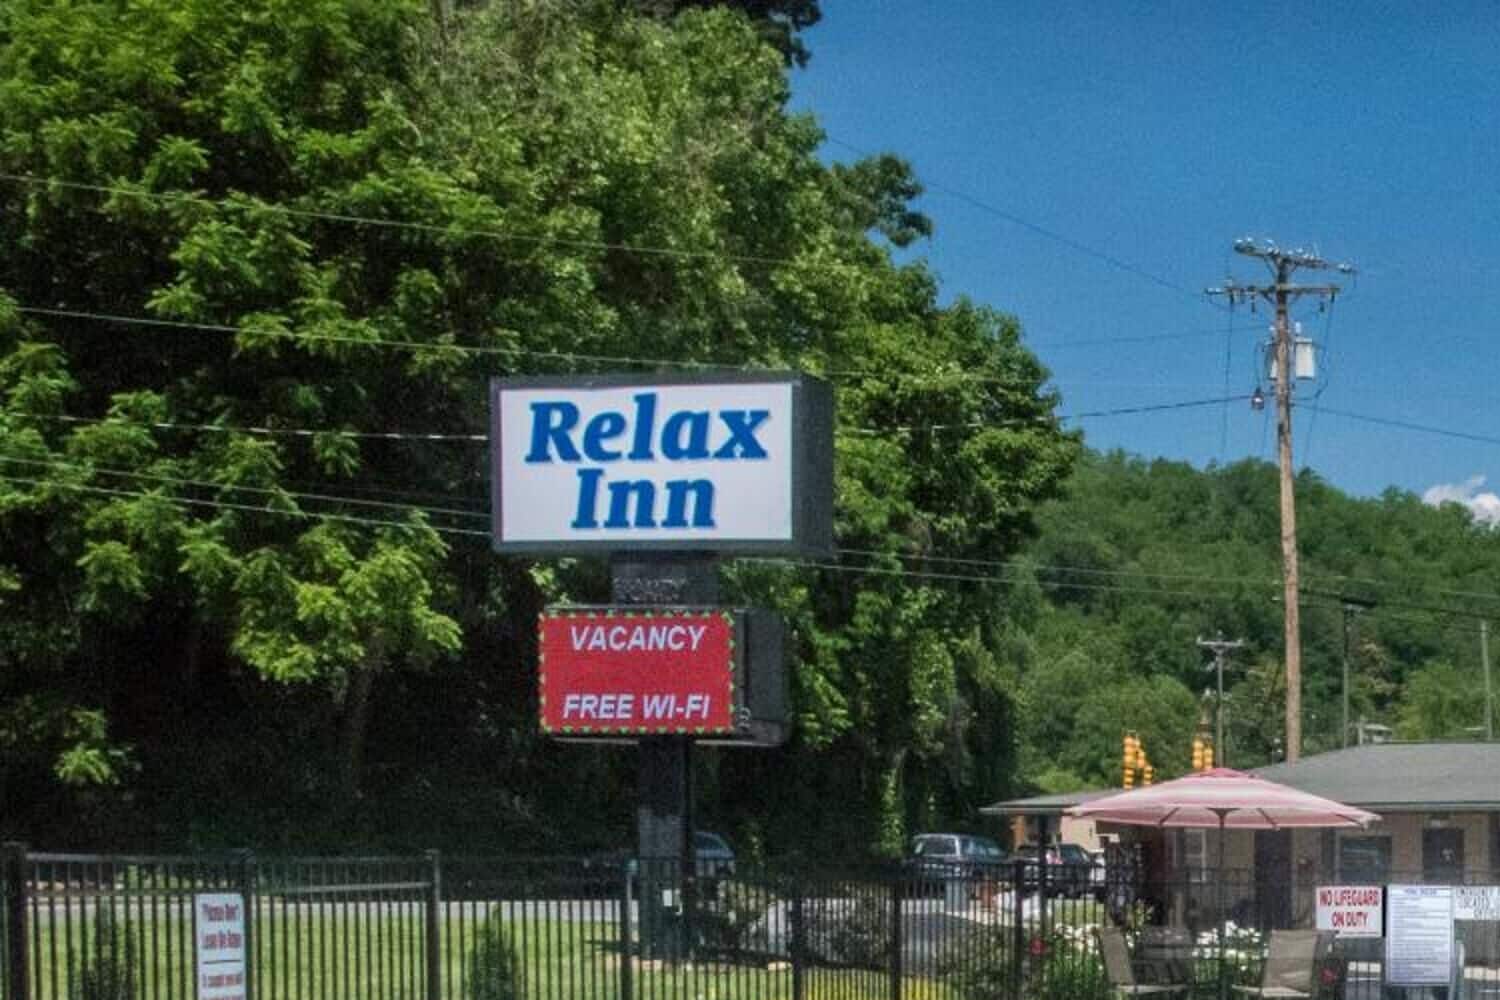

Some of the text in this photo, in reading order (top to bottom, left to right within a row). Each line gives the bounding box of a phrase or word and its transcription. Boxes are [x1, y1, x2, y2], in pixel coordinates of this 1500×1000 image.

[524, 392, 770, 464] Relax
[571, 468, 716, 529] Inn
[570, 625, 705, 651] VACANCY
[562, 694, 710, 719] FREE WI-FI
[1319, 889, 1379, 907] NO LIFEGUARD
[1331, 912, 1368, 927] ON DUTY
